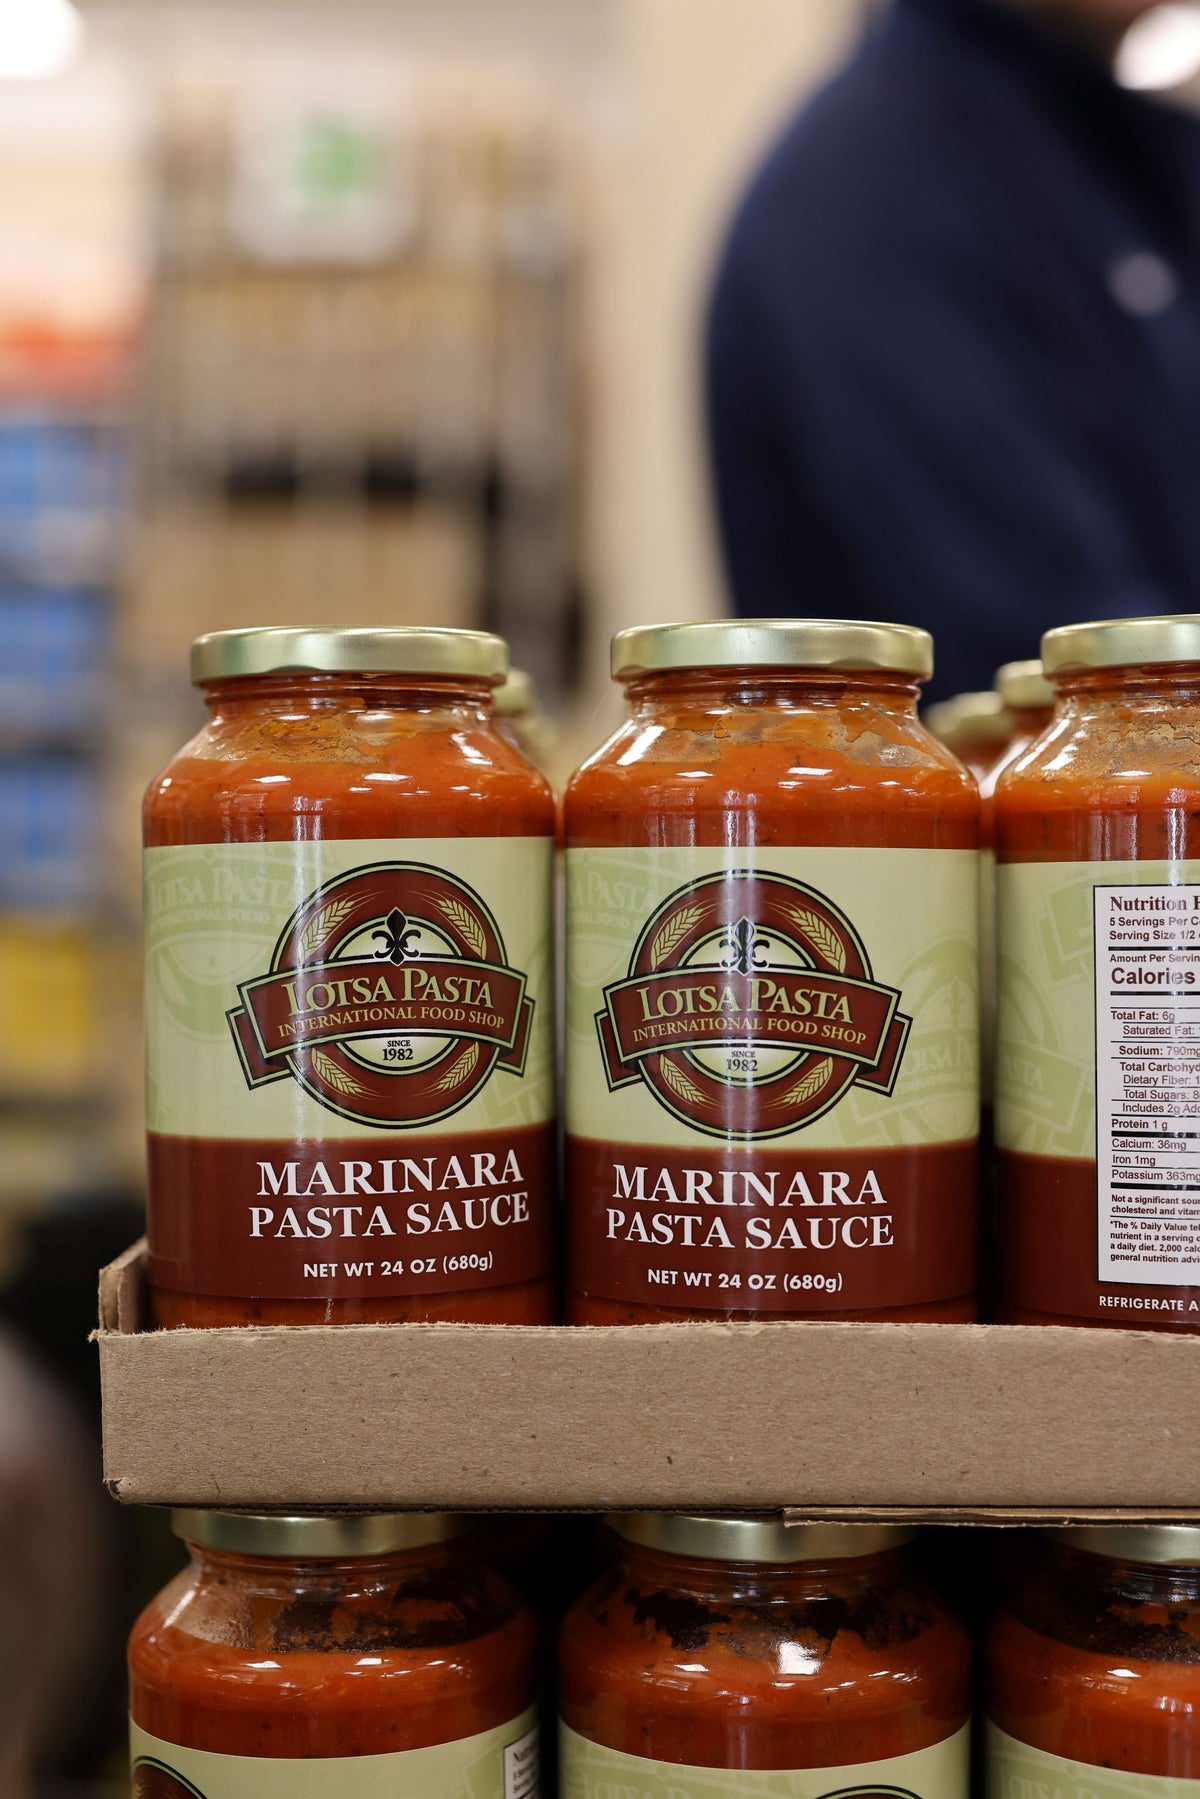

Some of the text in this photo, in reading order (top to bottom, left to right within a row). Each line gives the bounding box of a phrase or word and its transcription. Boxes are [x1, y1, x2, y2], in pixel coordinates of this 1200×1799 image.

[1110, 895, 1187, 911] Nutrition
[1109, 917, 1116, 927] 5
[1118, 916, 1165, 928] Servings
[1169, 916, 1188, 926] Per
[1109, 930, 1150, 942] Serving
[1153, 930, 1176, 940] Size
[1180, 930, 1196, 940] 1/2
[1109, 954, 1147, 962] Amount
[1149, 954, 1166, 962] Per
[1111, 967, 1196, 985] Calories
[282, 968, 495, 1017] LOTSA PASTA
[637, 978, 853, 1024] LOTSA PASTA
[277, 1006, 505, 1038] INTERNATIONAL FOOD SHOP
[1111, 1011, 1175, 1023] Total Fat: 6g
[633, 1017, 867, 1045] INTERNATIONAL FOOD SHOP
[1123, 1025, 1171, 1035] Saturated
[1174, 1025, 1195, 1035] Fat:
[382, 1040, 414, 1061] SINCE 1982
[1119, 1045, 1163, 1055] Sodium:
[726, 1059, 758, 1072] 1982
[1120, 1062, 1145, 1071] Total
[1123, 1075, 1158, 1086] Dietary
[1162, 1075, 1191, 1084] Fiber:
[1123, 1089, 1147, 1099] Total
[1150, 1089, 1189, 1101] Sugars:
[1122, 1103, 1164, 1113] Includes
[1167, 1104, 1180, 1115] 2g
[1111, 1119, 1168, 1131] Protein 1 g
[1111, 1138, 1187, 1152] Calcium: 36mg
[1113, 1154, 1156, 1167] Iron 1mg
[256, 1149, 524, 1196] MARINARA
[1111, 1169, 1163, 1181] Potassium
[612, 1164, 887, 1207] MARINARA
[1112, 1194, 1126, 1203] Not
[1135, 1196, 1179, 1205] significant
[249, 1191, 530, 1239] PASTA SAUCE
[1112, 1206, 1157, 1215] cholesterol
[1159, 1207, 1176, 1215] and
[606, 1208, 894, 1250] PASTA SAUCE
[1130, 1222, 1139, 1230] %
[1140, 1222, 1162, 1232] Daily
[1163, 1223, 1188, 1231] Value
[1110, 1232, 1142, 1241] nutrient
[1144, 1233, 1152, 1241] in
[1161, 1234, 1194, 1244] serving
[1117, 1242, 1137, 1252] daily
[1139, 1243, 1157, 1251] diet.
[1159, 1244, 1182, 1253] 2,000
[1110, 1253, 1141, 1262] general
[1142, 1254, 1179, 1263] nutrition
[303, 1251, 493, 1278] NET WT 24 OZ (680g)
[647, 1269, 843, 1294] NET WT 24 OZ (680g)
[1099, 1295, 1184, 1311] REFRIGERATE
